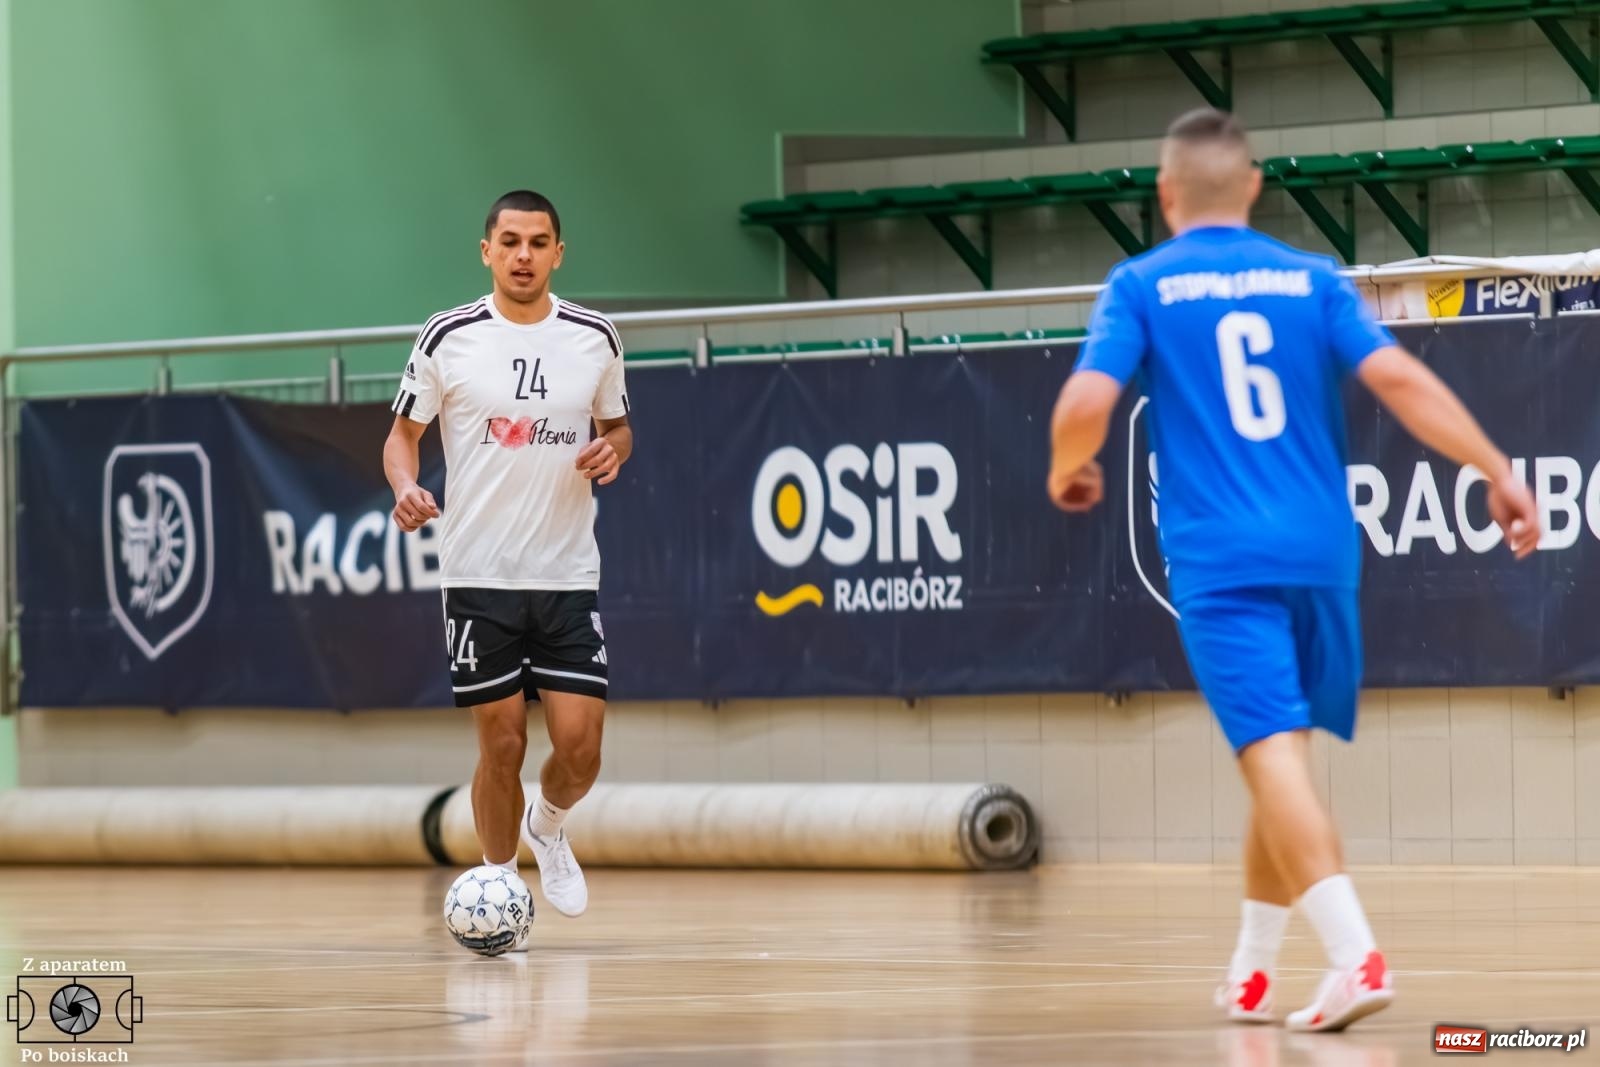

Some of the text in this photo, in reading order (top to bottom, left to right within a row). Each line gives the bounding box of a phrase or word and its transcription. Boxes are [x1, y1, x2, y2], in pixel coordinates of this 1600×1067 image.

[513, 358, 548, 400] 24
[1216, 311, 1286, 441] 6
[752, 441, 963, 568] OSiR
[834, 566, 964, 612] RACIBÓRZ
